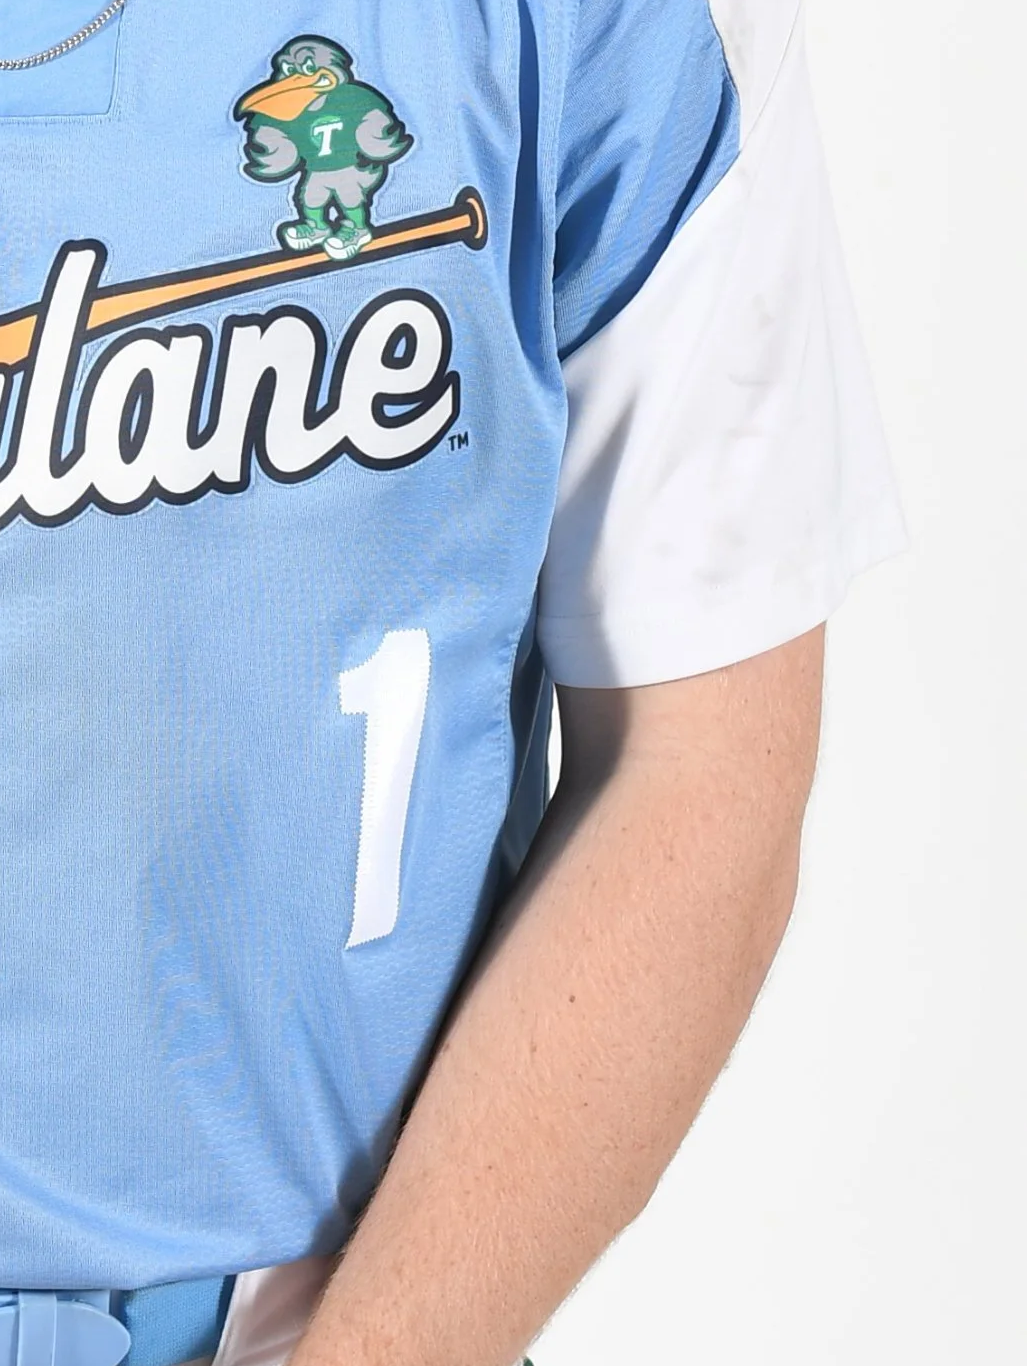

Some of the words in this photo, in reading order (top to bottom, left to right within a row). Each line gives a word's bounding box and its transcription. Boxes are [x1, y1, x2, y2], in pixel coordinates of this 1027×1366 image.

[313, 121, 344, 157] T
[447, 430, 470, 452] TM
[338, 628, 432, 951] 1
